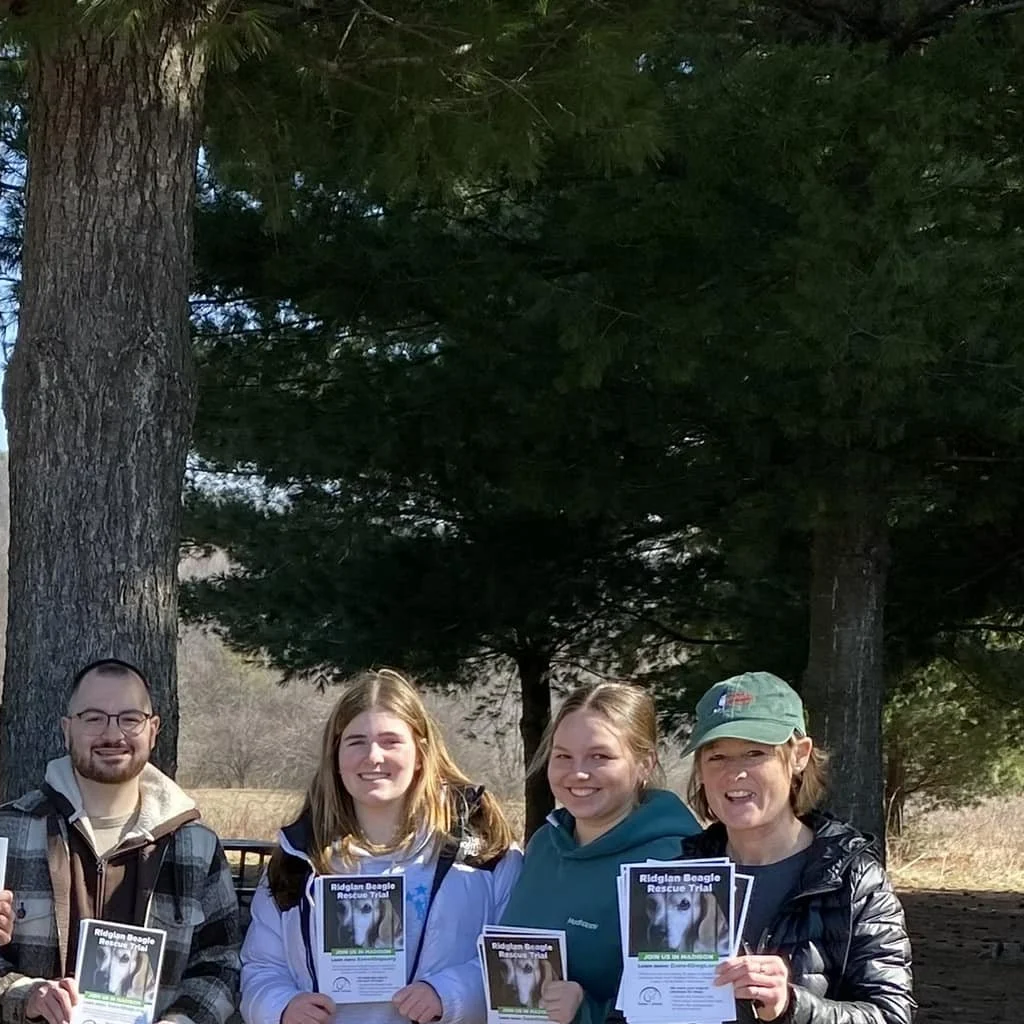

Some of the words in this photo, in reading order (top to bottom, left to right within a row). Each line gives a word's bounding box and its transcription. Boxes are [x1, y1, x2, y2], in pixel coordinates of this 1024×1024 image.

[639, 874, 681, 884] Ridglan
[683, 873, 721, 883] Beagle
[330, 883, 364, 892] Ridglan
[365, 882, 396, 891] Beagle
[647, 884, 686, 893] Rescue
[688, 884, 713, 892] Trial
[94, 928, 126, 940] Ridglan
[127, 933, 156, 945] Beagle
[99, 938, 128, 949] Rescue
[130, 943, 148, 952] Trial
[492, 942, 524, 951] Ridglan
[524, 943, 553, 952] Beagle
[498, 951, 528, 959] Rescue
[529, 951, 548, 960] Trial
